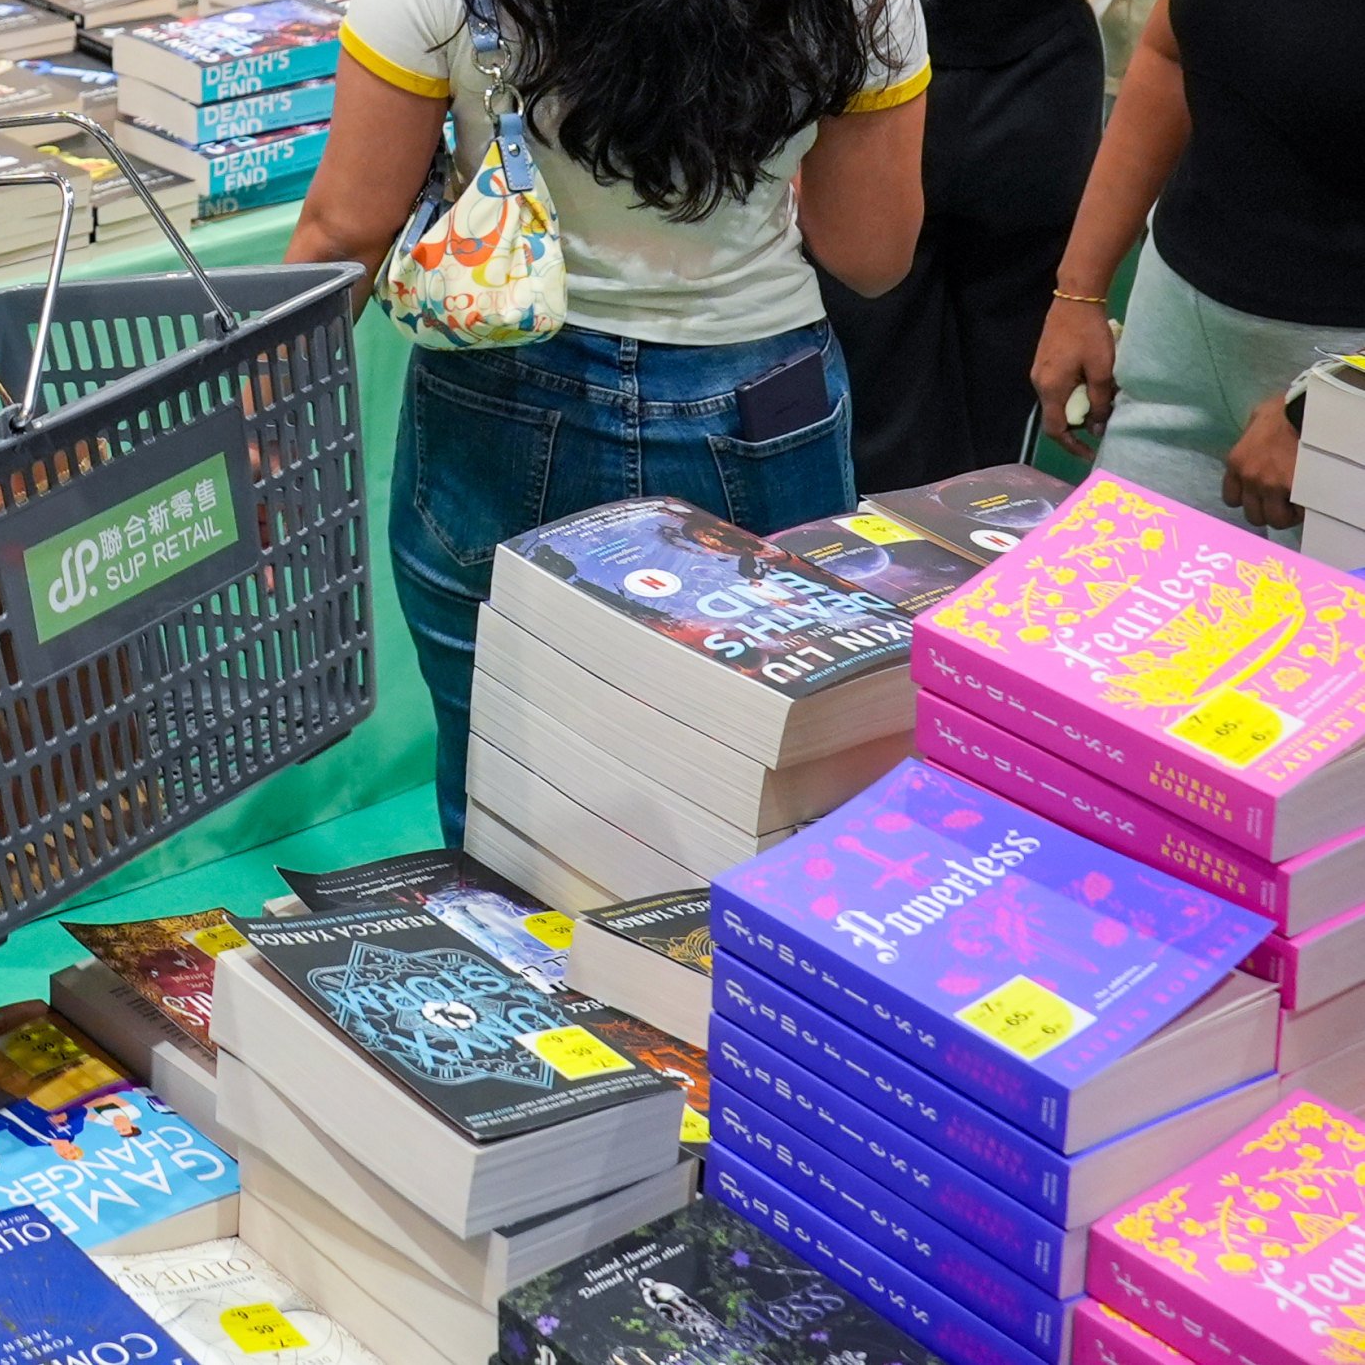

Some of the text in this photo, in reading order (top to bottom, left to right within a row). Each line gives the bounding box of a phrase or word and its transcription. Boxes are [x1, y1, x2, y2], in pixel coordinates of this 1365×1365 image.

[206, 49, 290, 85] DEATH'S
[203, 92, 292, 126] DEATH'S
[217, 78, 262, 100] END
[217, 119, 262, 143] END
[213, 140, 294, 176] DEATH'S
[225, 168, 268, 191] END
[99, 478, 217, 560] 聯合新零售
[106, 516, 223, 591] SUP RETAIL
[696, 569, 827, 617] END
[704, 590, 898, 658] DEATH'S
[762, 646, 835, 683] LIU
[1265, 717, 1354, 782] LAUREN
[1149, 774, 1233, 822] ROBERTS
[1154, 761, 1227, 803] LAUREN
[1161, 845, 1246, 894] ROBERTS
[1166, 834, 1238, 876] LAUREN
[832, 829, 1041, 965] Powerless
[248, 914, 436, 947] REBECCA YARROS
[607, 907, 676, 932] YARROS
[330, 964, 509, 1017] STORM
[34, 1148, 225, 1236] GAME
[157, 1257, 252, 1287] OLIVIE
[579, 1275, 624, 1299] Destined
